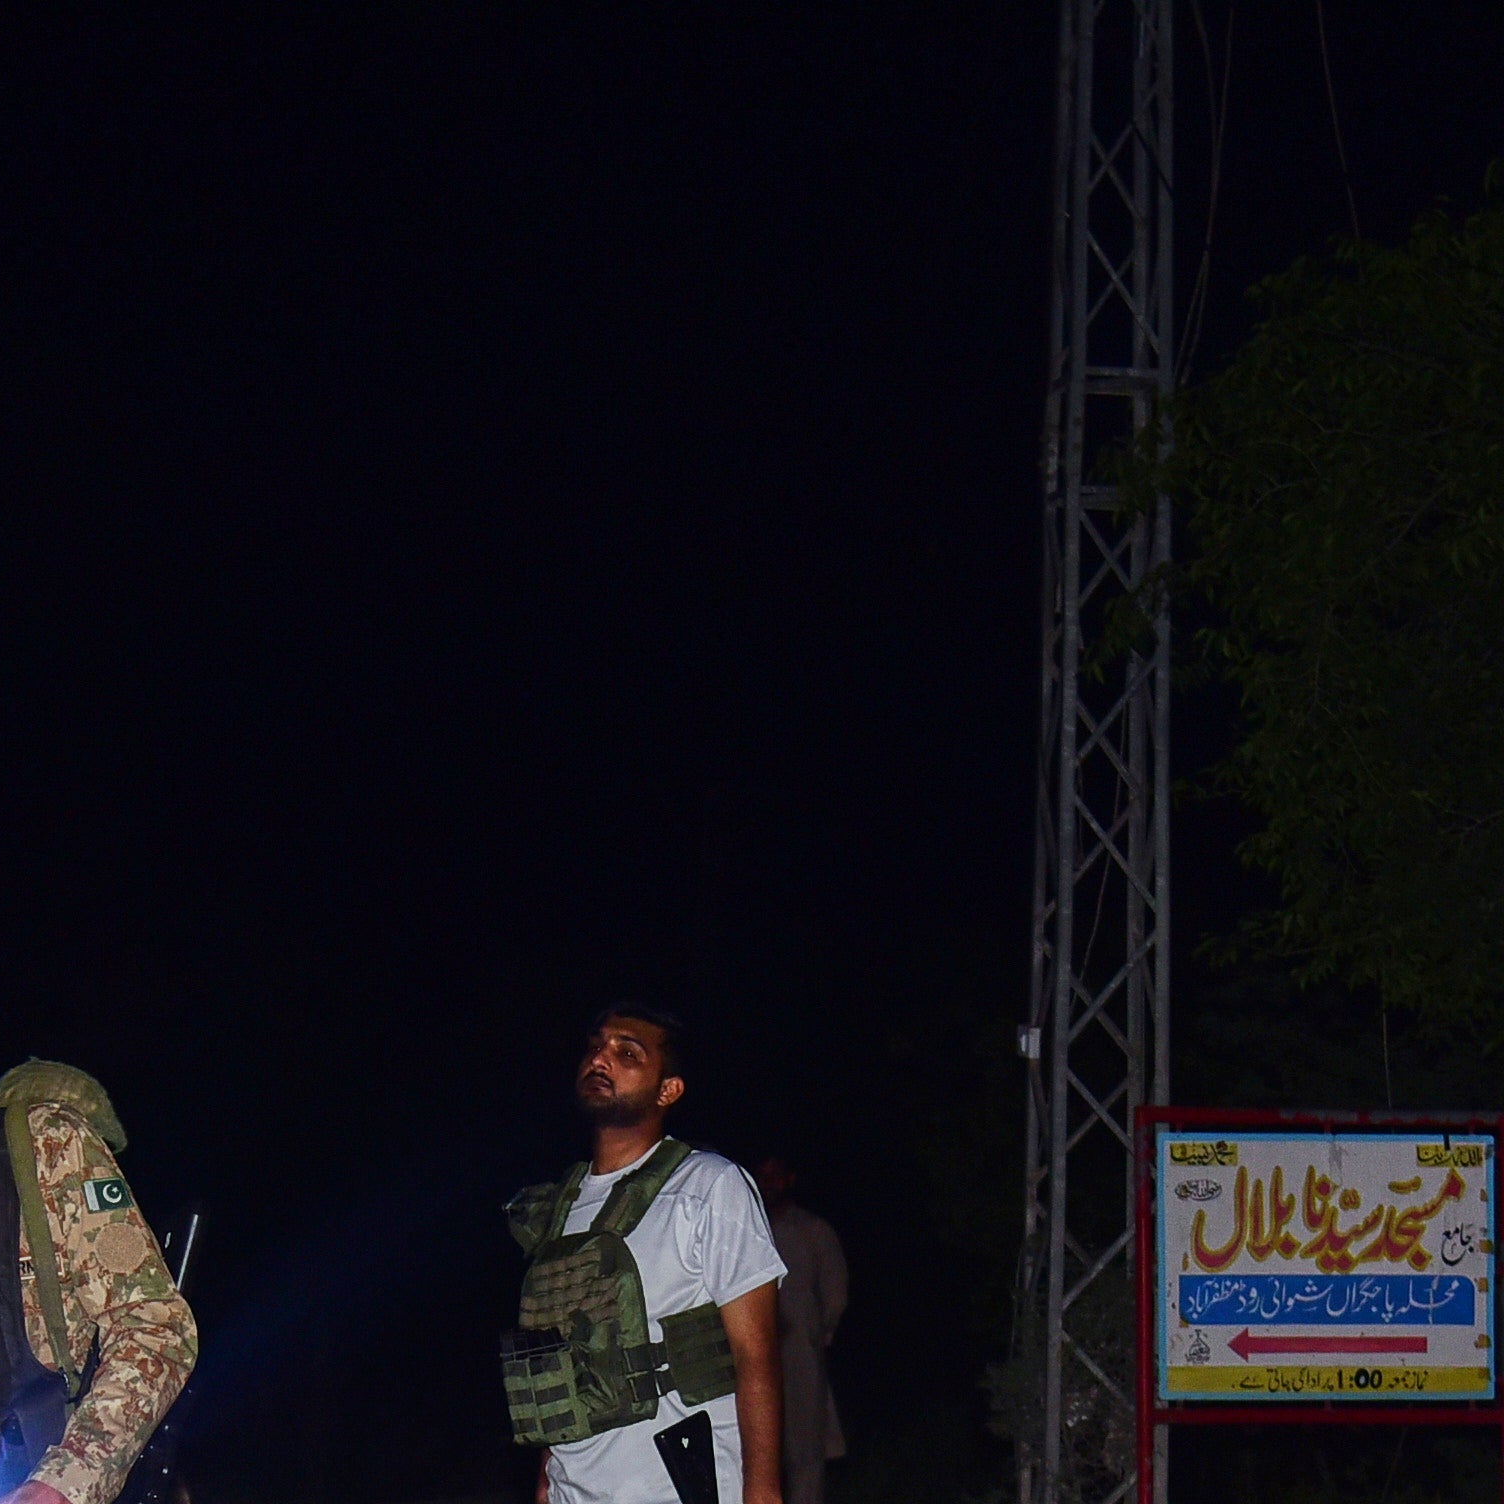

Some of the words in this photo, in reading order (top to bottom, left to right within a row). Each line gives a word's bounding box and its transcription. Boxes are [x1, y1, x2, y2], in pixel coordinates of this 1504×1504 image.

[1190, 1165, 1301, 1273] بلال
[1357, 1167, 1466, 1272] مسجد
[1441, 1222, 1475, 1267] جامع
[1337, 1367, 1383, 1390] 1:00
